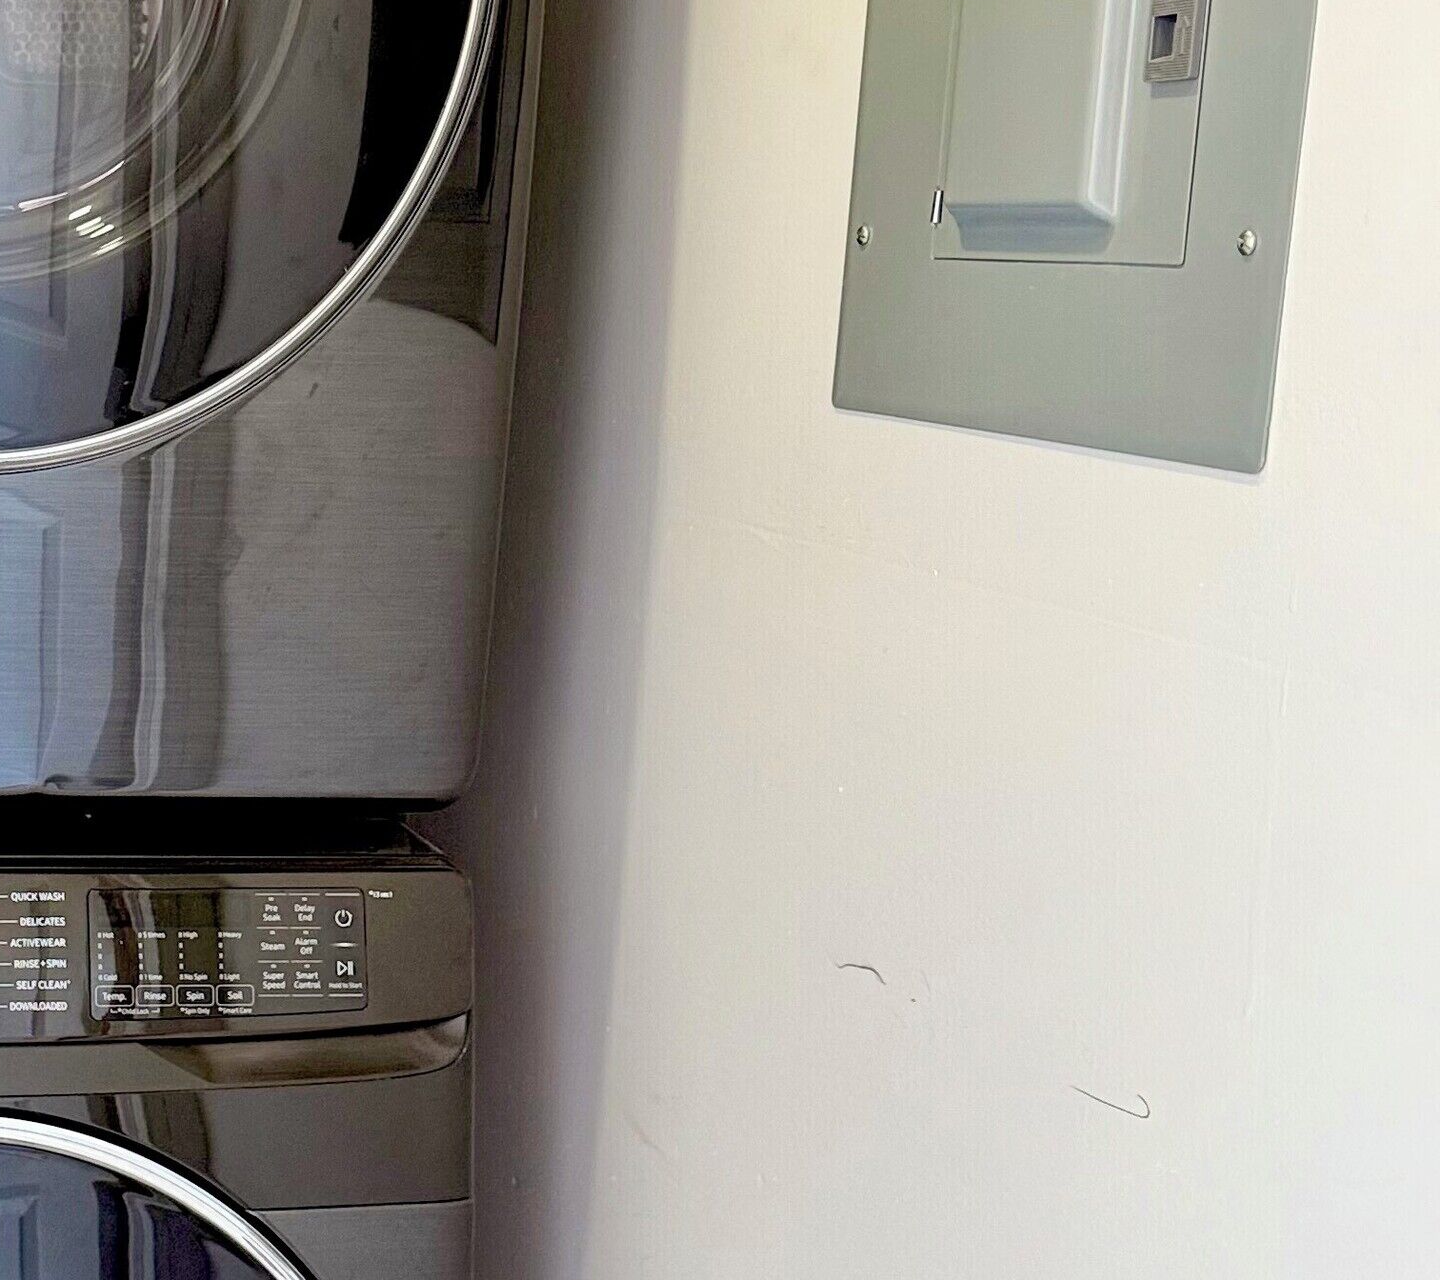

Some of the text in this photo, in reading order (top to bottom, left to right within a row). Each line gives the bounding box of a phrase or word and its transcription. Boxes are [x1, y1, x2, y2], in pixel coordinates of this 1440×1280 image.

[10, 891, 66, 902] QUICK WASH
[19, 916, 66, 927] DELICATES
[10, 938, 67, 948] ACTIVEWEAR
[260, 941, 285, 951] Steam
[294, 937, 318, 946] Alarm
[299, 946, 313, 955] Off
[13, 959, 40, 969] RINSE
[46, 959, 67, 969] SPIN
[295, 971, 319, 980] Smart
[15, 980, 37, 990] SELF
[293, 980, 321, 989] Control
[143, 990, 167, 1001] Rinse
[186, 990, 205, 1002] Spin
[227, 990, 243, 1000] Soil
[9, 1001, 68, 1011] DOWNLOADED
